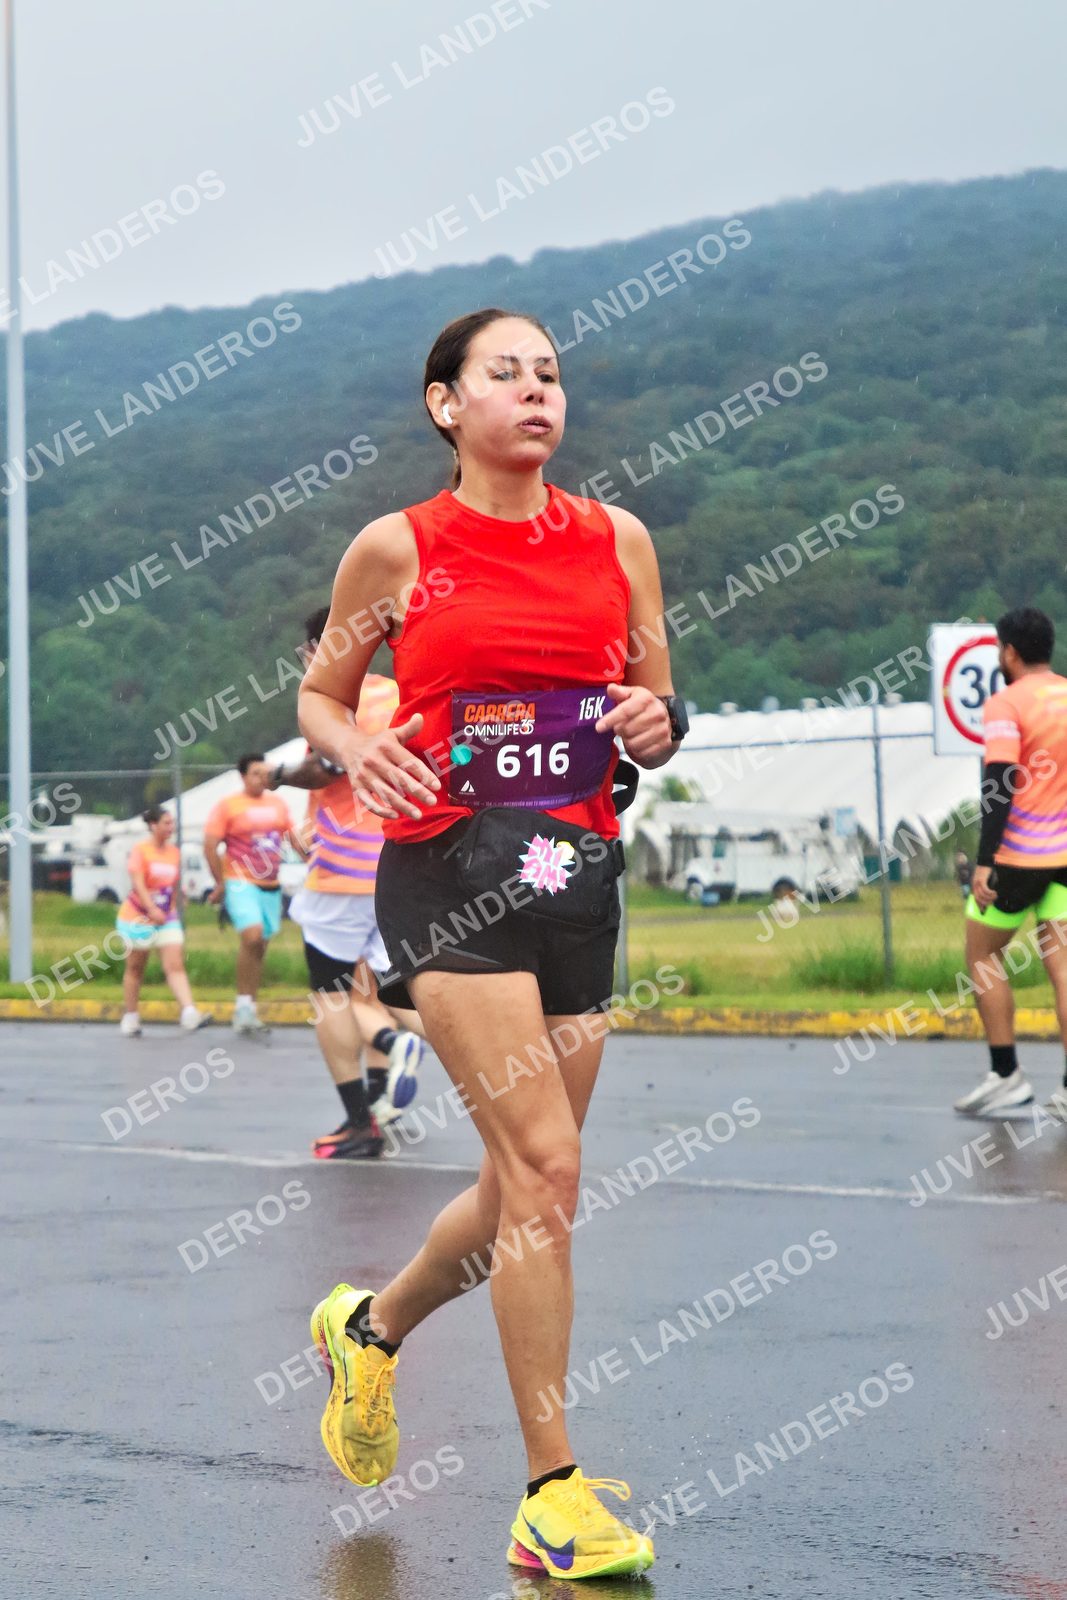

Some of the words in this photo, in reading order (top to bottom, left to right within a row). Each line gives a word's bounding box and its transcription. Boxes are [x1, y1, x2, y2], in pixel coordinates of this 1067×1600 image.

[464, 703, 536, 723] CARRERA
[578, 695, 607, 720] 15K
[463, 723, 520, 737] OMNILIFE
[496, 741, 570, 778] 616
